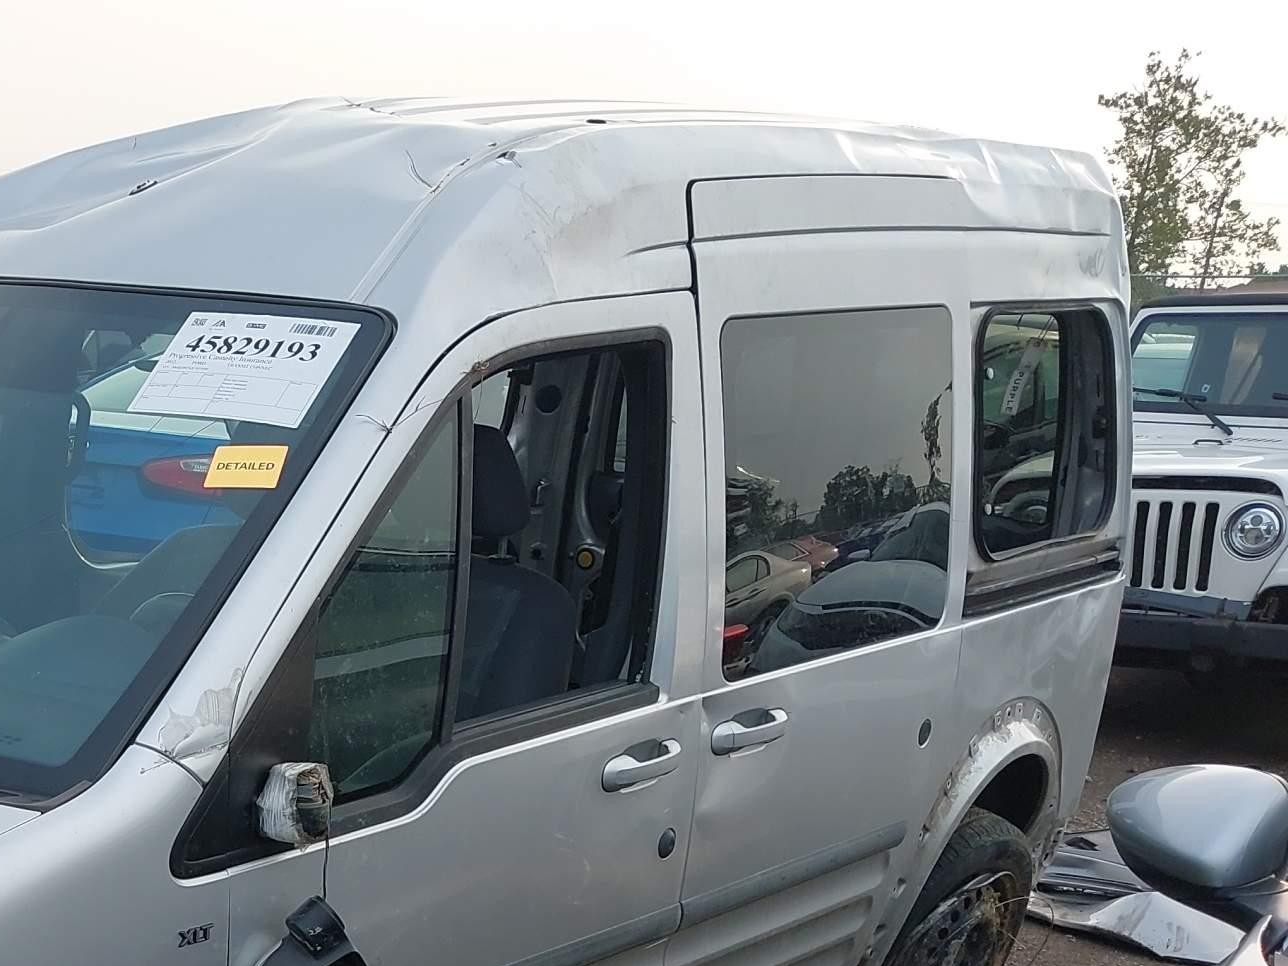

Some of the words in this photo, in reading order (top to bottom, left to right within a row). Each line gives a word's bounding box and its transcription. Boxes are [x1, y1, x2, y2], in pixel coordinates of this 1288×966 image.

[186, 334, 321, 362] 45829193
[216, 462, 275, 471] DETAILED
[177, 922, 216, 949] XLT
